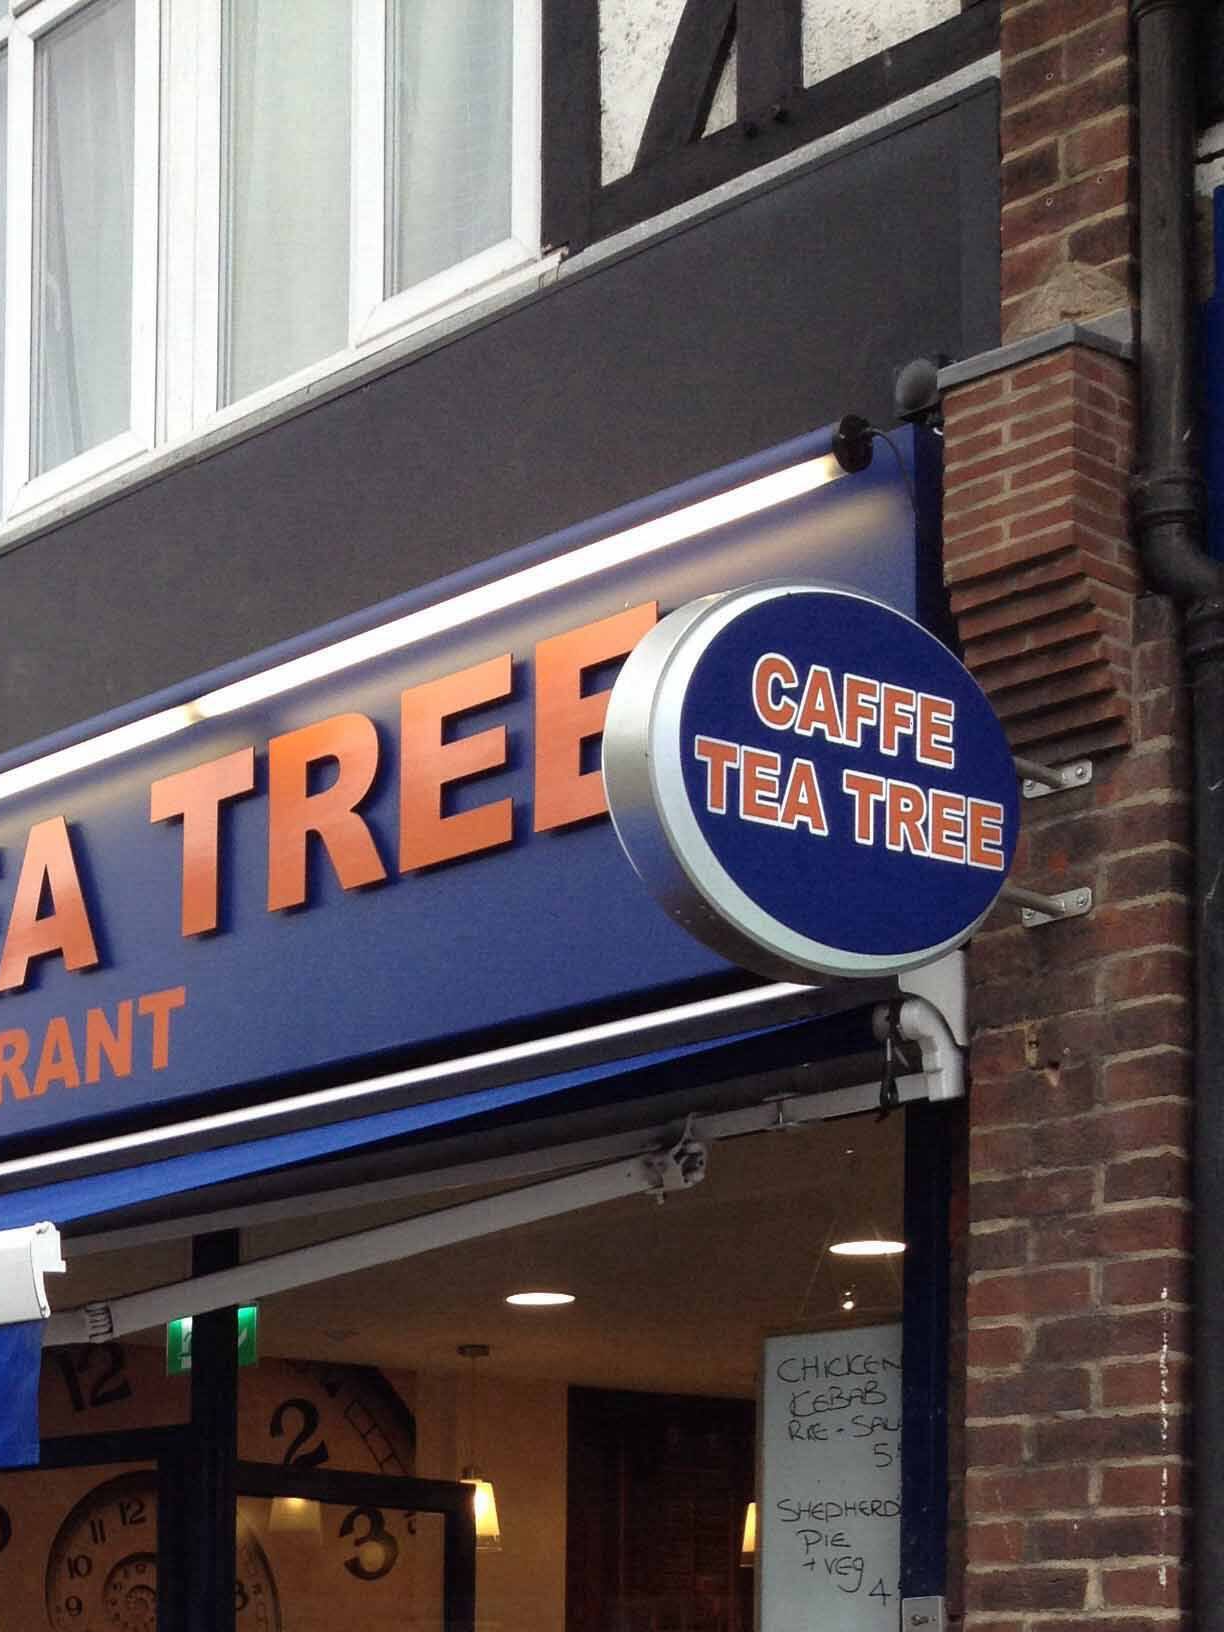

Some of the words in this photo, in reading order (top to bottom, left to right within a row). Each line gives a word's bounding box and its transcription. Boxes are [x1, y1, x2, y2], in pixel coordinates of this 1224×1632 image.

[751, 652, 955, 769] CAFFE
[150, 600, 659, 938] TREE
[694, 734, 829, 837] TEA
[842, 768, 1004, 871] TREE
[777, 1354, 902, 1384] CHICKEN
[270, 1398, 329, 1467] 2
[338, 1505, 399, 1581] 3
[795, 1529, 852, 1554] PIE
